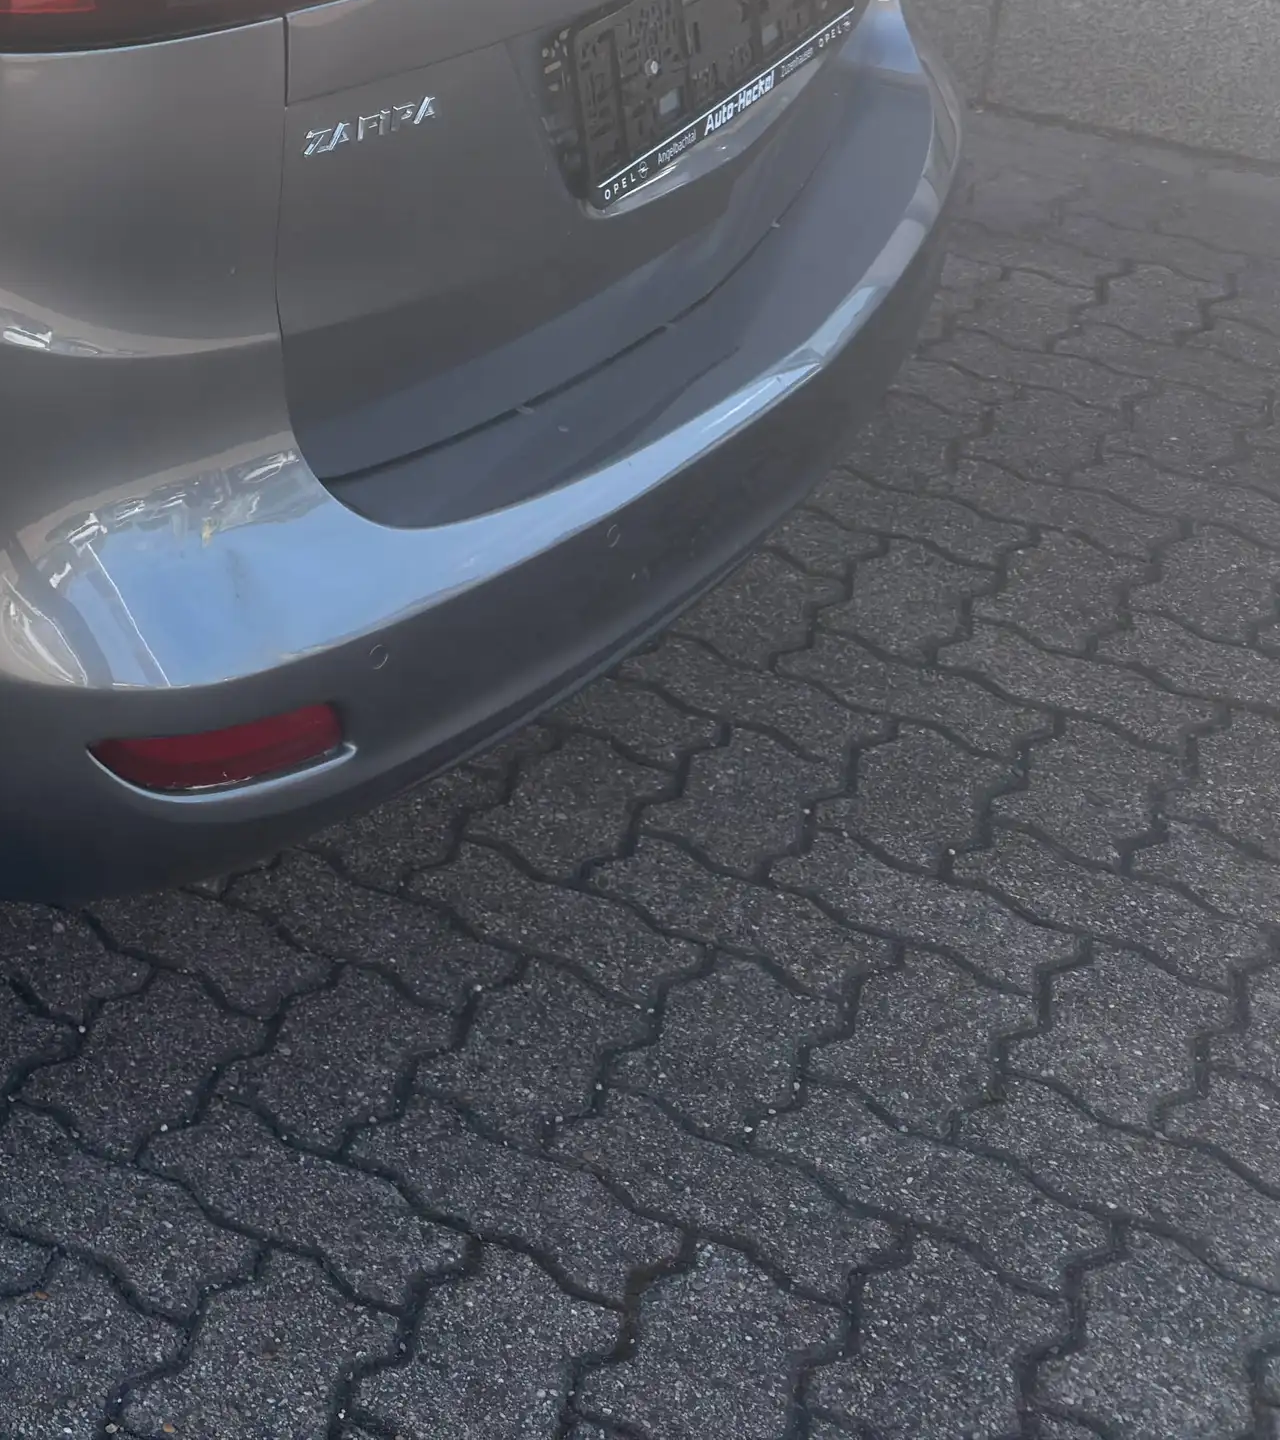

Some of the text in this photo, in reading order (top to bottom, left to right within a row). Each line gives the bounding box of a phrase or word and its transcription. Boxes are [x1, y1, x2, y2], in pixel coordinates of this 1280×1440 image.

[303, 96, 437, 158] ZAFIRA
[604, 172, 637, 200] OPEL
[657, 129, 697, 165] Angelbachtal
[704, 70, 775, 136] Auto-Heckel
[818, 25, 842, 48] OPEL
